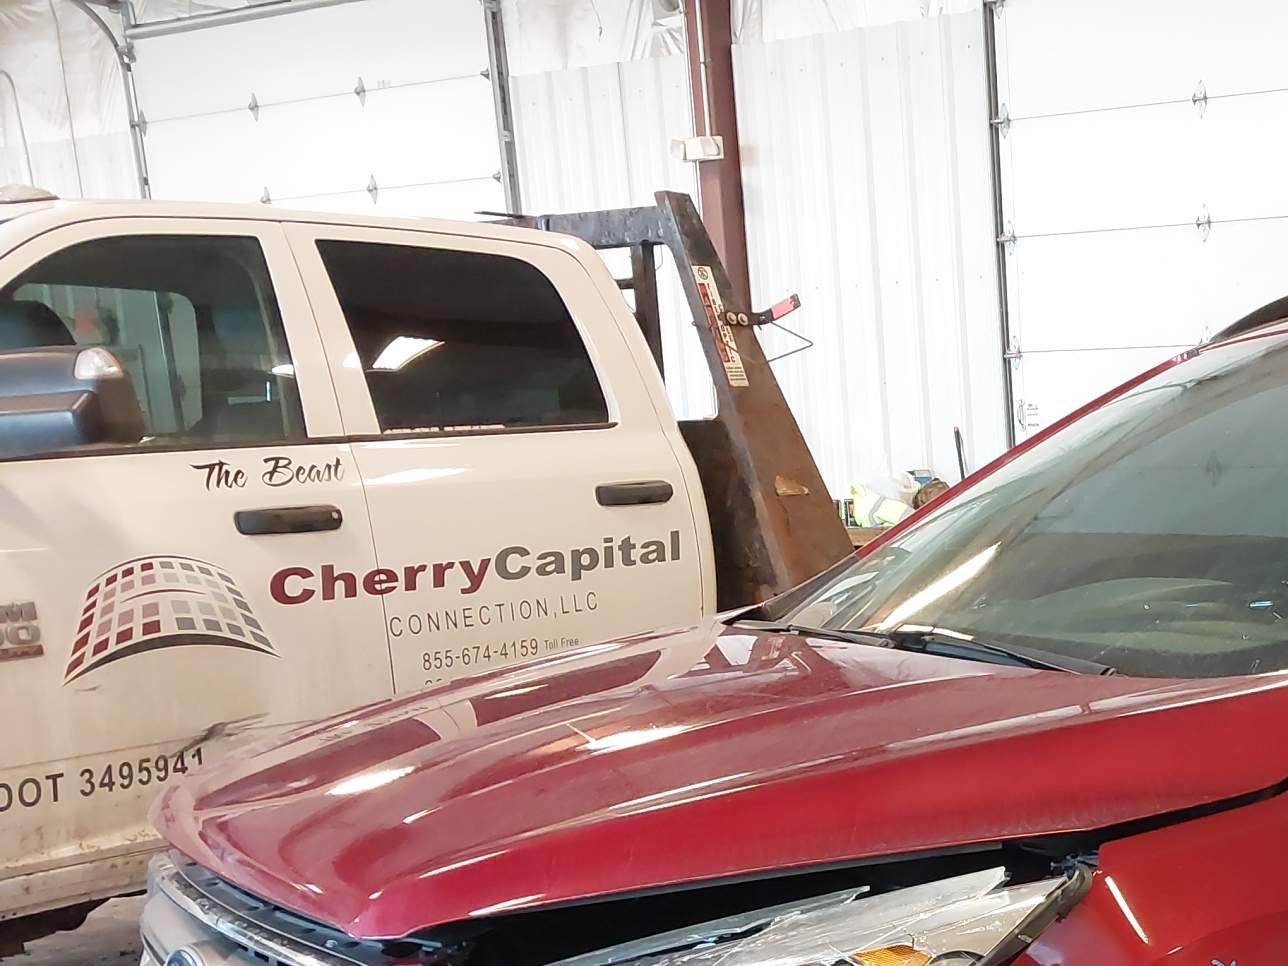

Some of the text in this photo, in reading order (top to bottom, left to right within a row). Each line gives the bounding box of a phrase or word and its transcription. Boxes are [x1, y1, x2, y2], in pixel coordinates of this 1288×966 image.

[189, 456, 344, 491] The Beast
[270, 530, 681, 605] CherryCapital
[422, 637, 579, 670] 855-674-4159 Toll Free
[79, 747, 203, 797] 3495941
